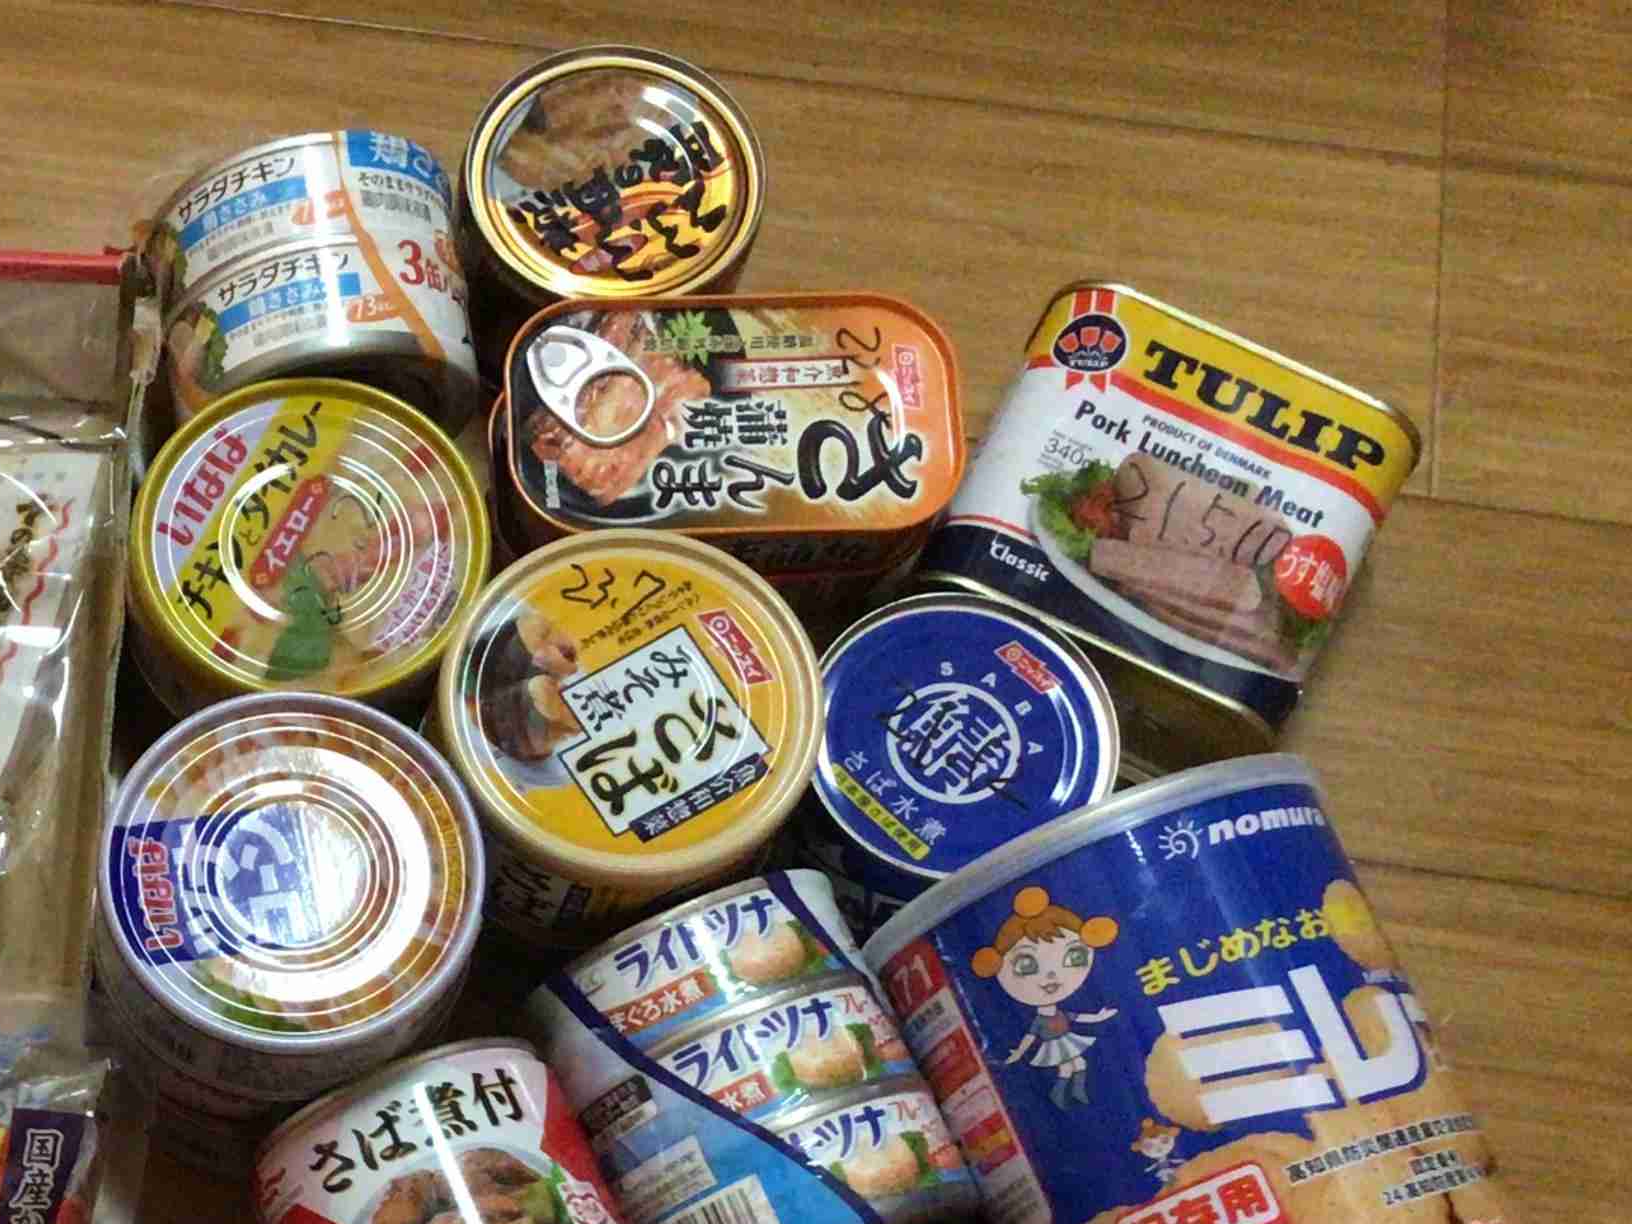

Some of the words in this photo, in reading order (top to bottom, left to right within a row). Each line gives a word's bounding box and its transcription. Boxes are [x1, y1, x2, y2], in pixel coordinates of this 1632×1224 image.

[178, 157, 296, 224] サラダチキン
[218, 252, 349, 307] サラダチキン
[681, 400, 790, 448] 蒲焼
[1141, 413, 1197, 447] PRODUCT
[1197, 439, 1216, 455] OF
[1214, 444, 1274, 479] DENMARK
[1143, 339, 1386, 472] TULIP
[156, 426, 248, 548] いなば
[651, 412, 924, 512] さんま
[1074, 399, 1132, 444] Pork
[1136, 430, 1252, 499] Luncheon
[1256, 482, 1328, 530] Meat
[264, 496, 317, 570] イエロー
[988, 536, 1052, 583] Classic
[560, 562, 668, 622] 23.7
[571, 643, 694, 732] みそ煮
[939, 660, 1045, 757] SABA
[574, 689, 740, 817] さば
[843, 750, 947, 846] さば水煮
[126, 836, 187, 953] いなば
[614, 894, 773, 989] ライトツナ
[671, 997, 833, 1091] ライトツナ
[309, 1067, 527, 1196] さば煮付
